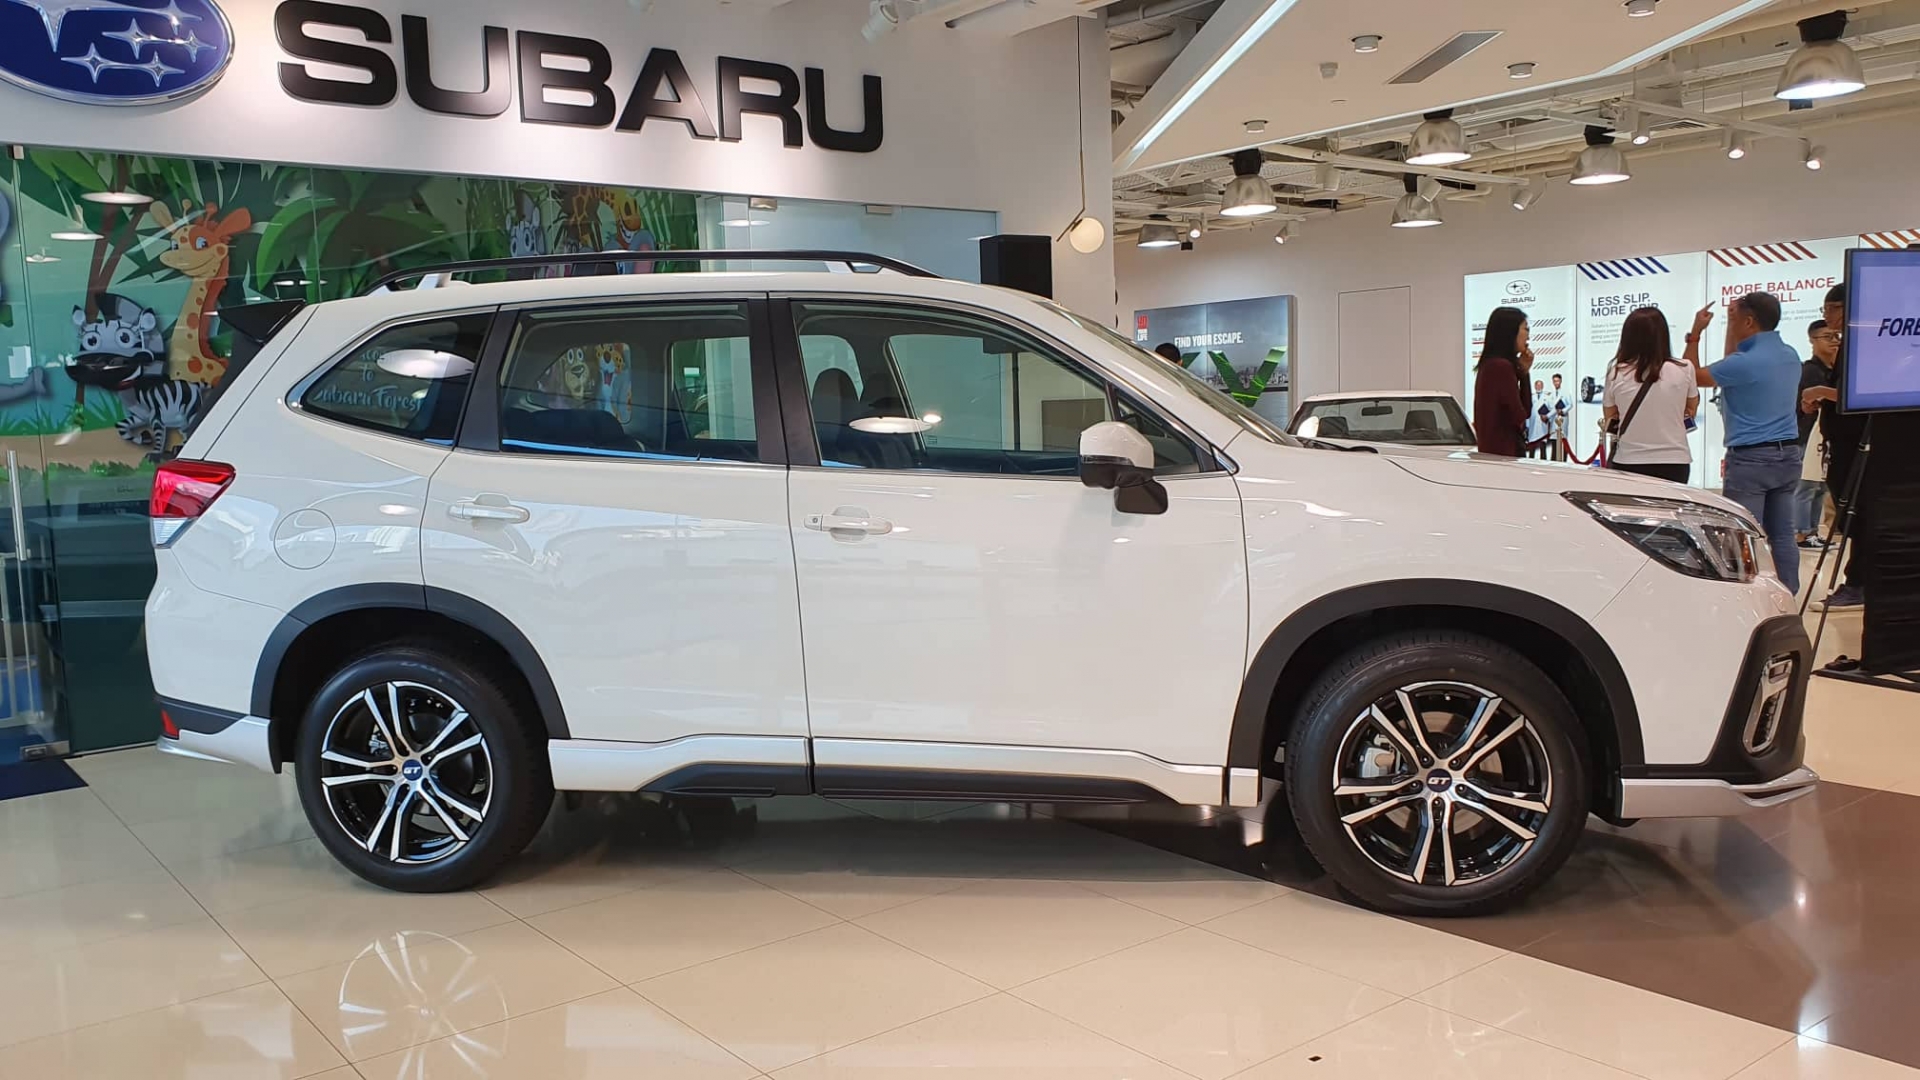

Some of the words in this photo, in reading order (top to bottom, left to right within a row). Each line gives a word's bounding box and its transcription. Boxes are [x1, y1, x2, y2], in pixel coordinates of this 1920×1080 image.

[274, 0, 883, 153] SUBARU
[1721, 283, 1762, 296] MORE
[1767, 277, 1836, 292] BALANCE
[1501, 296, 1536, 304] SUBARU
[1591, 295, 1620, 307] LESS
[1623, 292, 1651, 304] SLIP.
[1591, 305, 1626, 317] MORE
[1174, 336, 1191, 348] FIND
[1192, 334, 1212, 347] YOUR
[1213, 331, 1244, 345] ESCAPE.
[404, 766, 421, 774] GT
[1428, 777, 1450, 785] GT
